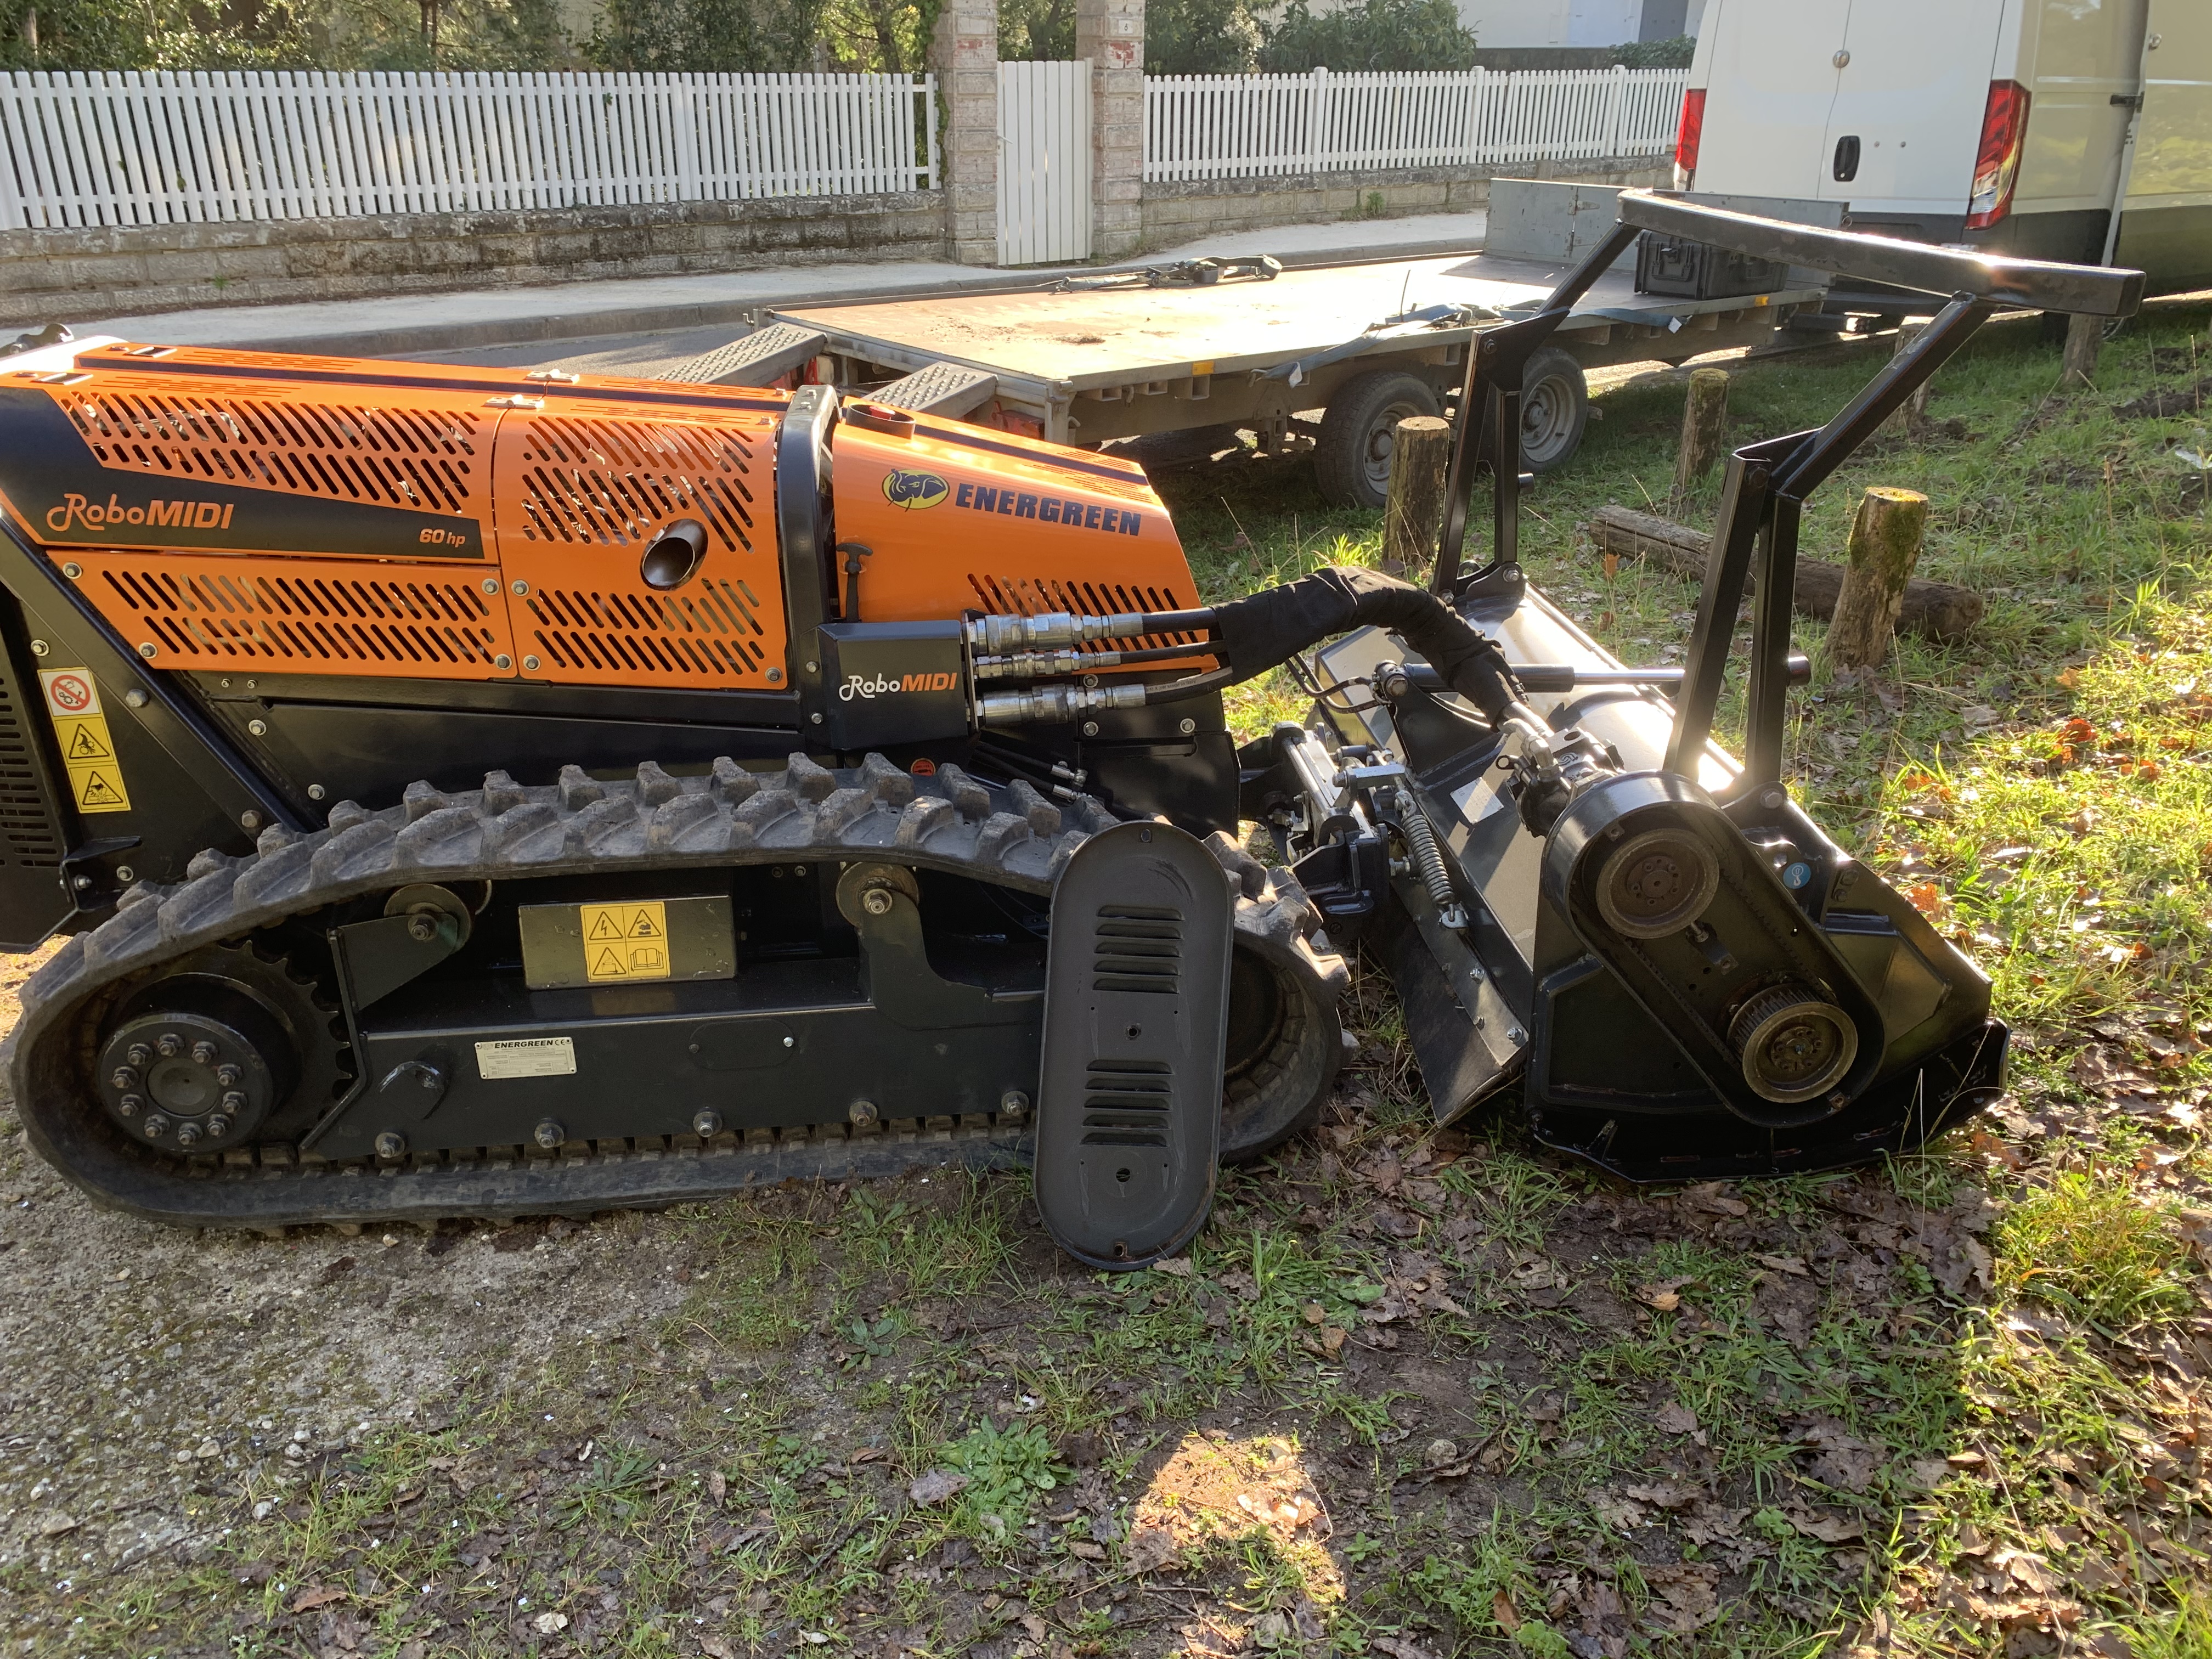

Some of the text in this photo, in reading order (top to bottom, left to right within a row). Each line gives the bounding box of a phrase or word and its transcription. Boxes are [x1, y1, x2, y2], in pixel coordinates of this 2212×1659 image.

[1124, 22, 1128, 31] 6
[955, 483, 1141, 536] ENERGREEN
[419, 528, 466, 548] 60 hp
[494, 1040, 553, 1048] ENERGREEN
